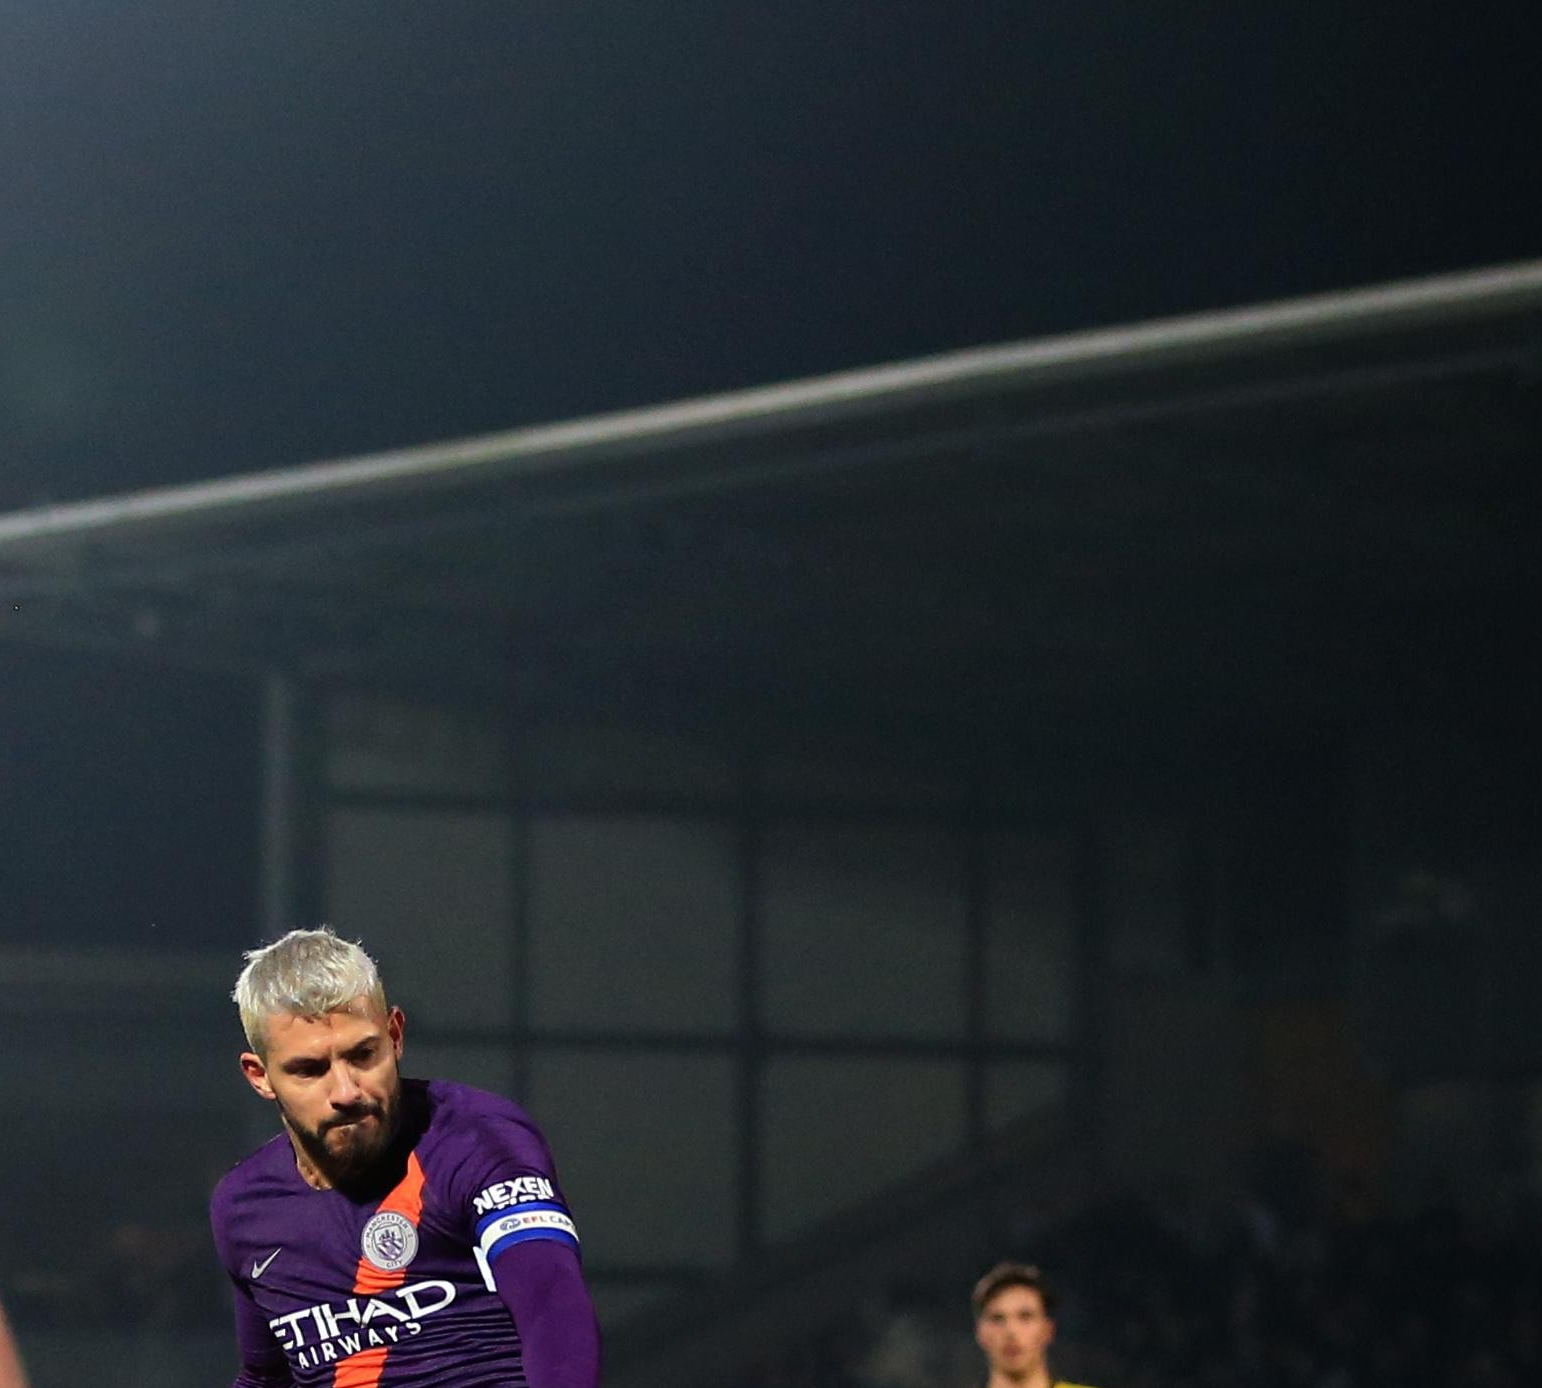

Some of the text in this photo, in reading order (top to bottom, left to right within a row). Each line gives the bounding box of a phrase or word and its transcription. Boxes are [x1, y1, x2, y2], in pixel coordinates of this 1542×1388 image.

[472, 1176, 555, 1216] NEXEN
[269, 1280, 457, 1350] ETIHAD
[298, 1321, 423, 1370] AIRWAYS
